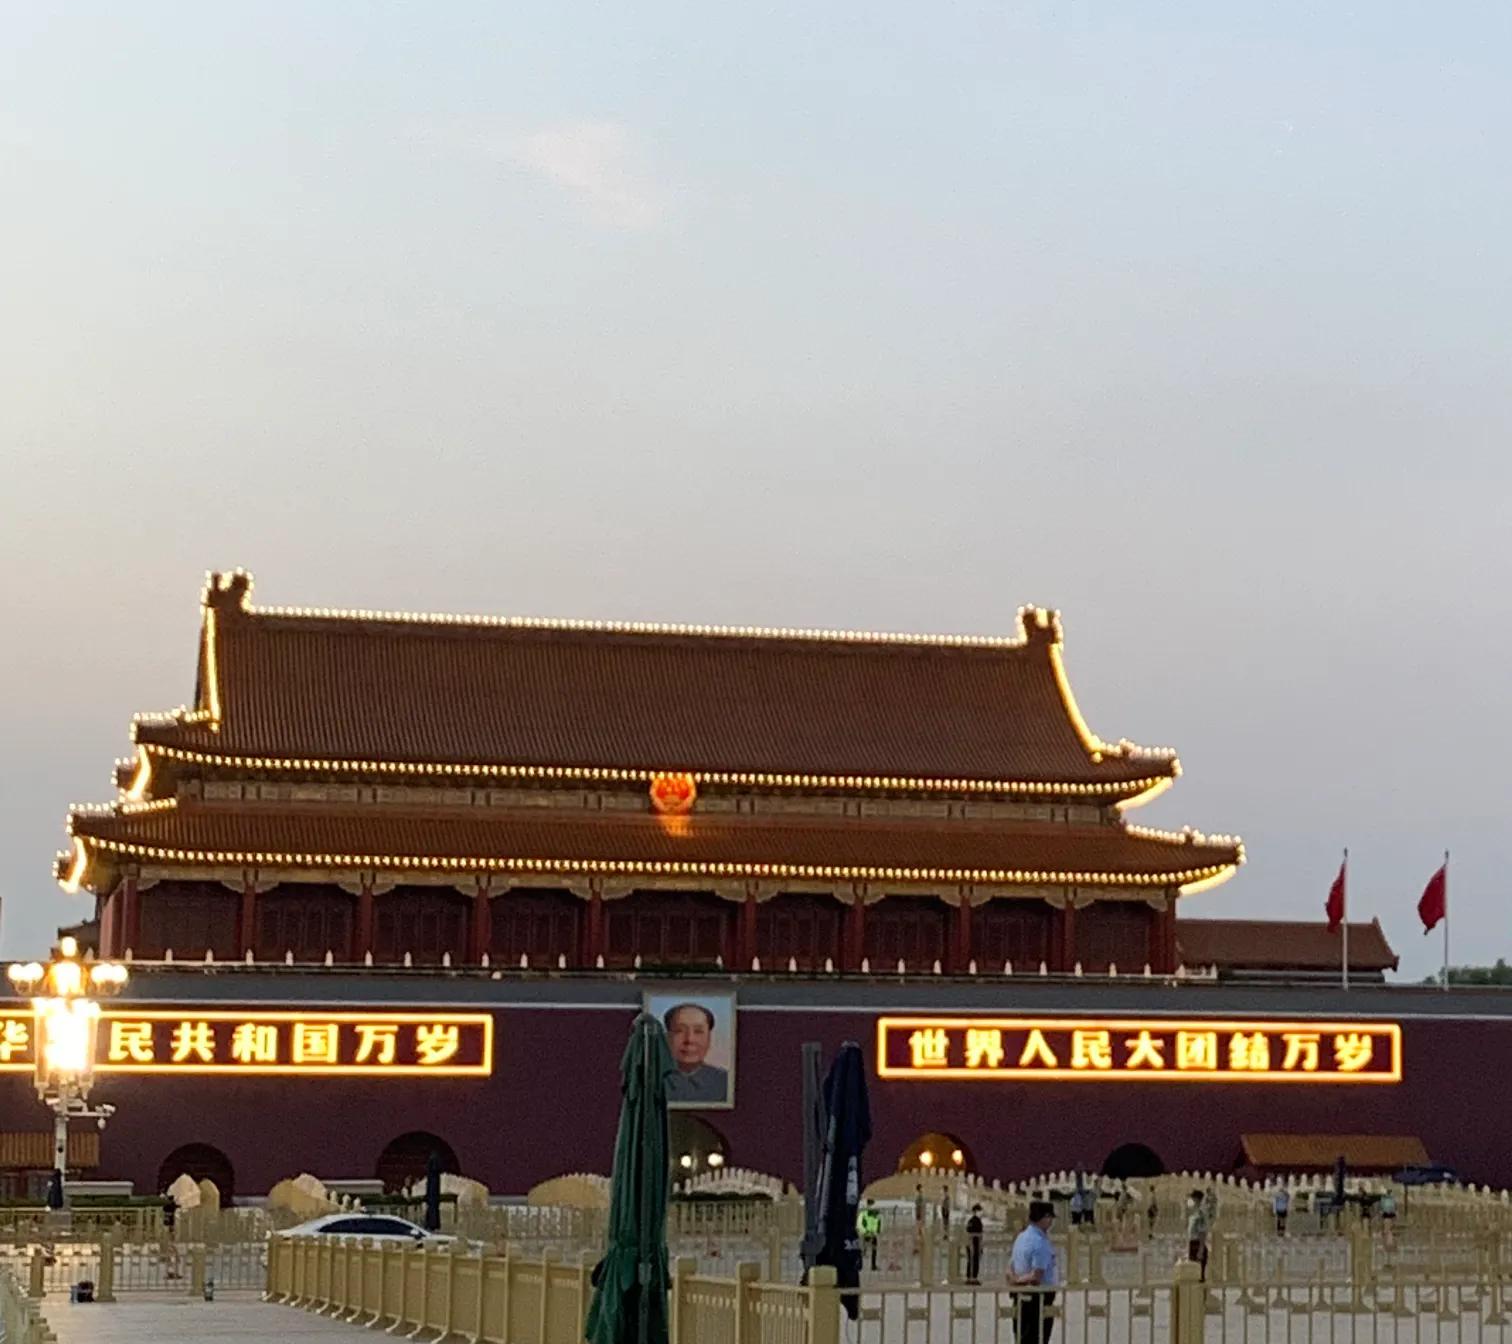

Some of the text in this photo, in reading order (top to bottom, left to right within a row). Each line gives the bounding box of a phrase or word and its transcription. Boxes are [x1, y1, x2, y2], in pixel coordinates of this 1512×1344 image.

[0, 1019, 460, 1064] 华民共和国万岁
[908, 1028, 1373, 1071] 世界人民大团结万岁
